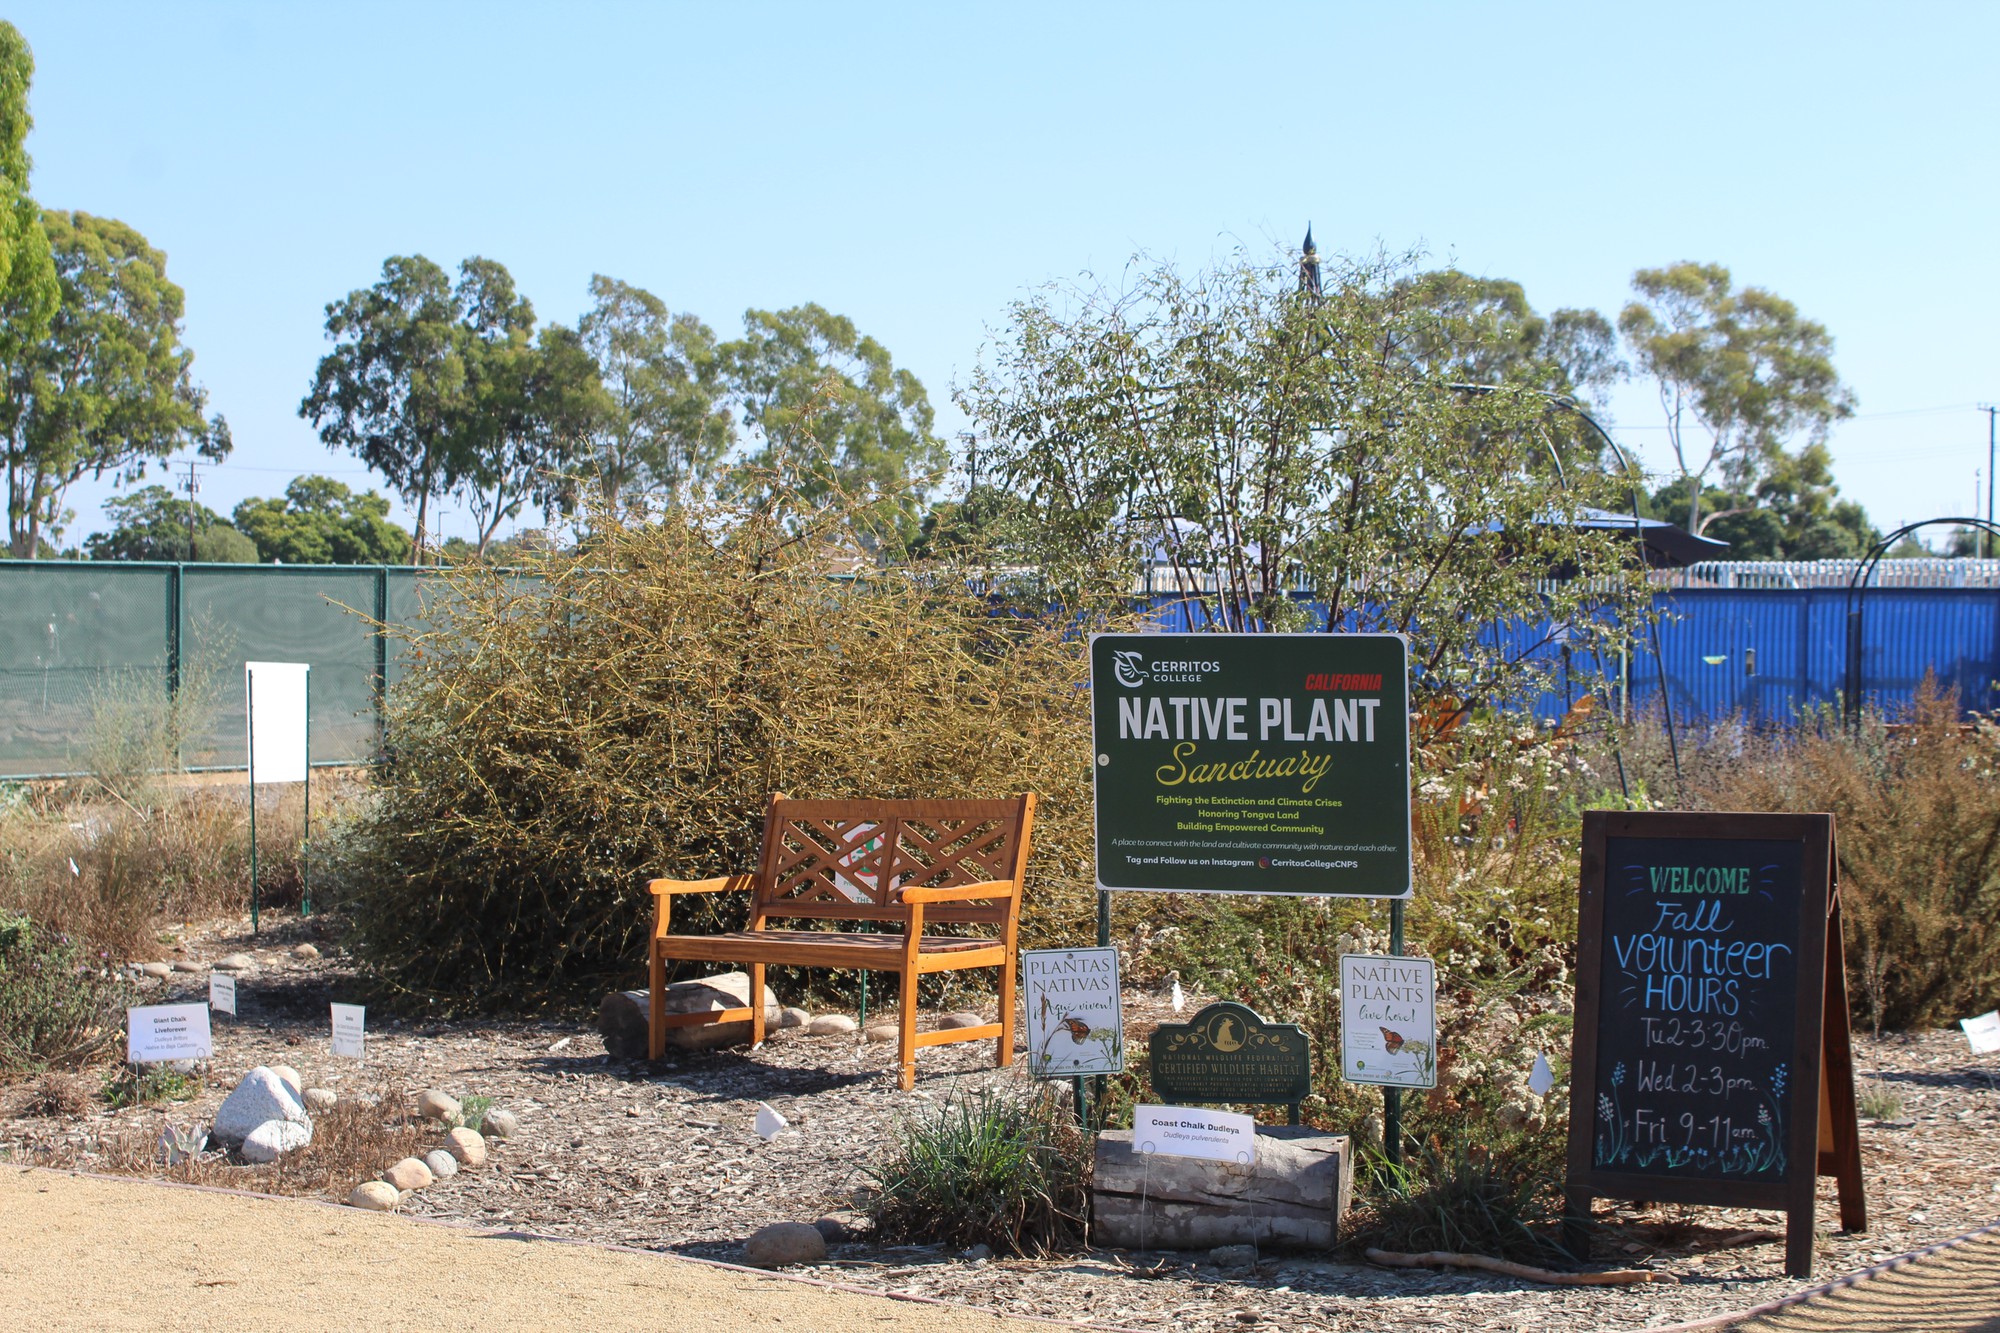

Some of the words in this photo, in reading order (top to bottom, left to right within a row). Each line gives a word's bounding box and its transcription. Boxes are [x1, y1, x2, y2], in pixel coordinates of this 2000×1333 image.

[1151, 661, 1220, 672] CERRITOS
[1153, 674, 1202, 682] COLLEGE
[1305, 673, 1382, 691] CALIFORNIA
[1118, 696, 1248, 741] NATIVE
[1259, 697, 1380, 742] PLANT
[1156, 741, 1334, 794] Sanctuary
[1156, 795, 1193, 806] Fighting
[1194, 796, 1209, 805] the
[1211, 796, 1256, 806] Extinction
[1257, 797, 1275, 806] and
[1277, 797, 1313, 807] Climate
[1314, 798, 1343, 807] Crises
[1198, 809, 1240, 820] Honoring
[1241, 810, 1275, 820] Tongva
[1276, 811, 1299, 820] Land
[1176, 822, 1214, 833] Building
[1215, 823, 1269, 833] Empowered
[1270, 824, 1324, 835] Community
[1111, 838, 1118, 846] A
[1118, 838, 1136, 847] place
[1137, 839, 1145, 847] to
[1146, 839, 1173, 848] connect
[1173, 839, 1189, 848] with
[1189, 840, 1201, 848] the
[1201, 840, 1218, 848] land
[1218, 841, 1232, 849] and
[1232, 841, 1261, 849] cultivate
[1262, 842, 1303, 852] community
[1303, 842, 1319, 850] with
[1319, 843, 1343, 851] nature
[1343, 843, 1359, 852] and
[1358, 843, 1376, 852] each
[1376, 844, 1398, 853] other.
[1125, 855, 1142, 866] Tag
[1142, 856, 1159, 865] and
[1160, 856, 1187, 865] Follow
[1188, 857, 1198, 866] us
[1199, 858, 1210, 866] on
[1211, 858, 1255, 868] Instagram
[1271, 859, 1359, 869] CerritosCollegeCNPS
[1649, 866, 1750, 894] WELCOME
[1652, 899, 1735, 933] Fall
[1030, 957, 1110, 975] PLANTAS
[1352, 966, 1423, 985] NATIVE
[1033, 976, 1110, 993] NATIVAS
[1352, 984, 1424, 1003] PLANTS
[1645, 974, 1740, 1016] HOURS
[1079, 995, 1112, 1010] viven!
[1359, 1004, 1384, 1021] live
[1384, 1005, 1415, 1022] here!
[1158, 1063, 1208, 1075] CERTIFIED
[1210, 1063, 1256, 1075] WILDLIFE
[1260, 1064, 1300, 1075] HABITAT
[1151, 1118, 1178, 1127] Coast
[1180, 1120, 1206, 1130] Chalk
[1207, 1123, 1240, 1135] Dudleya
[1163, 1131, 1190, 1140] Dudleya
